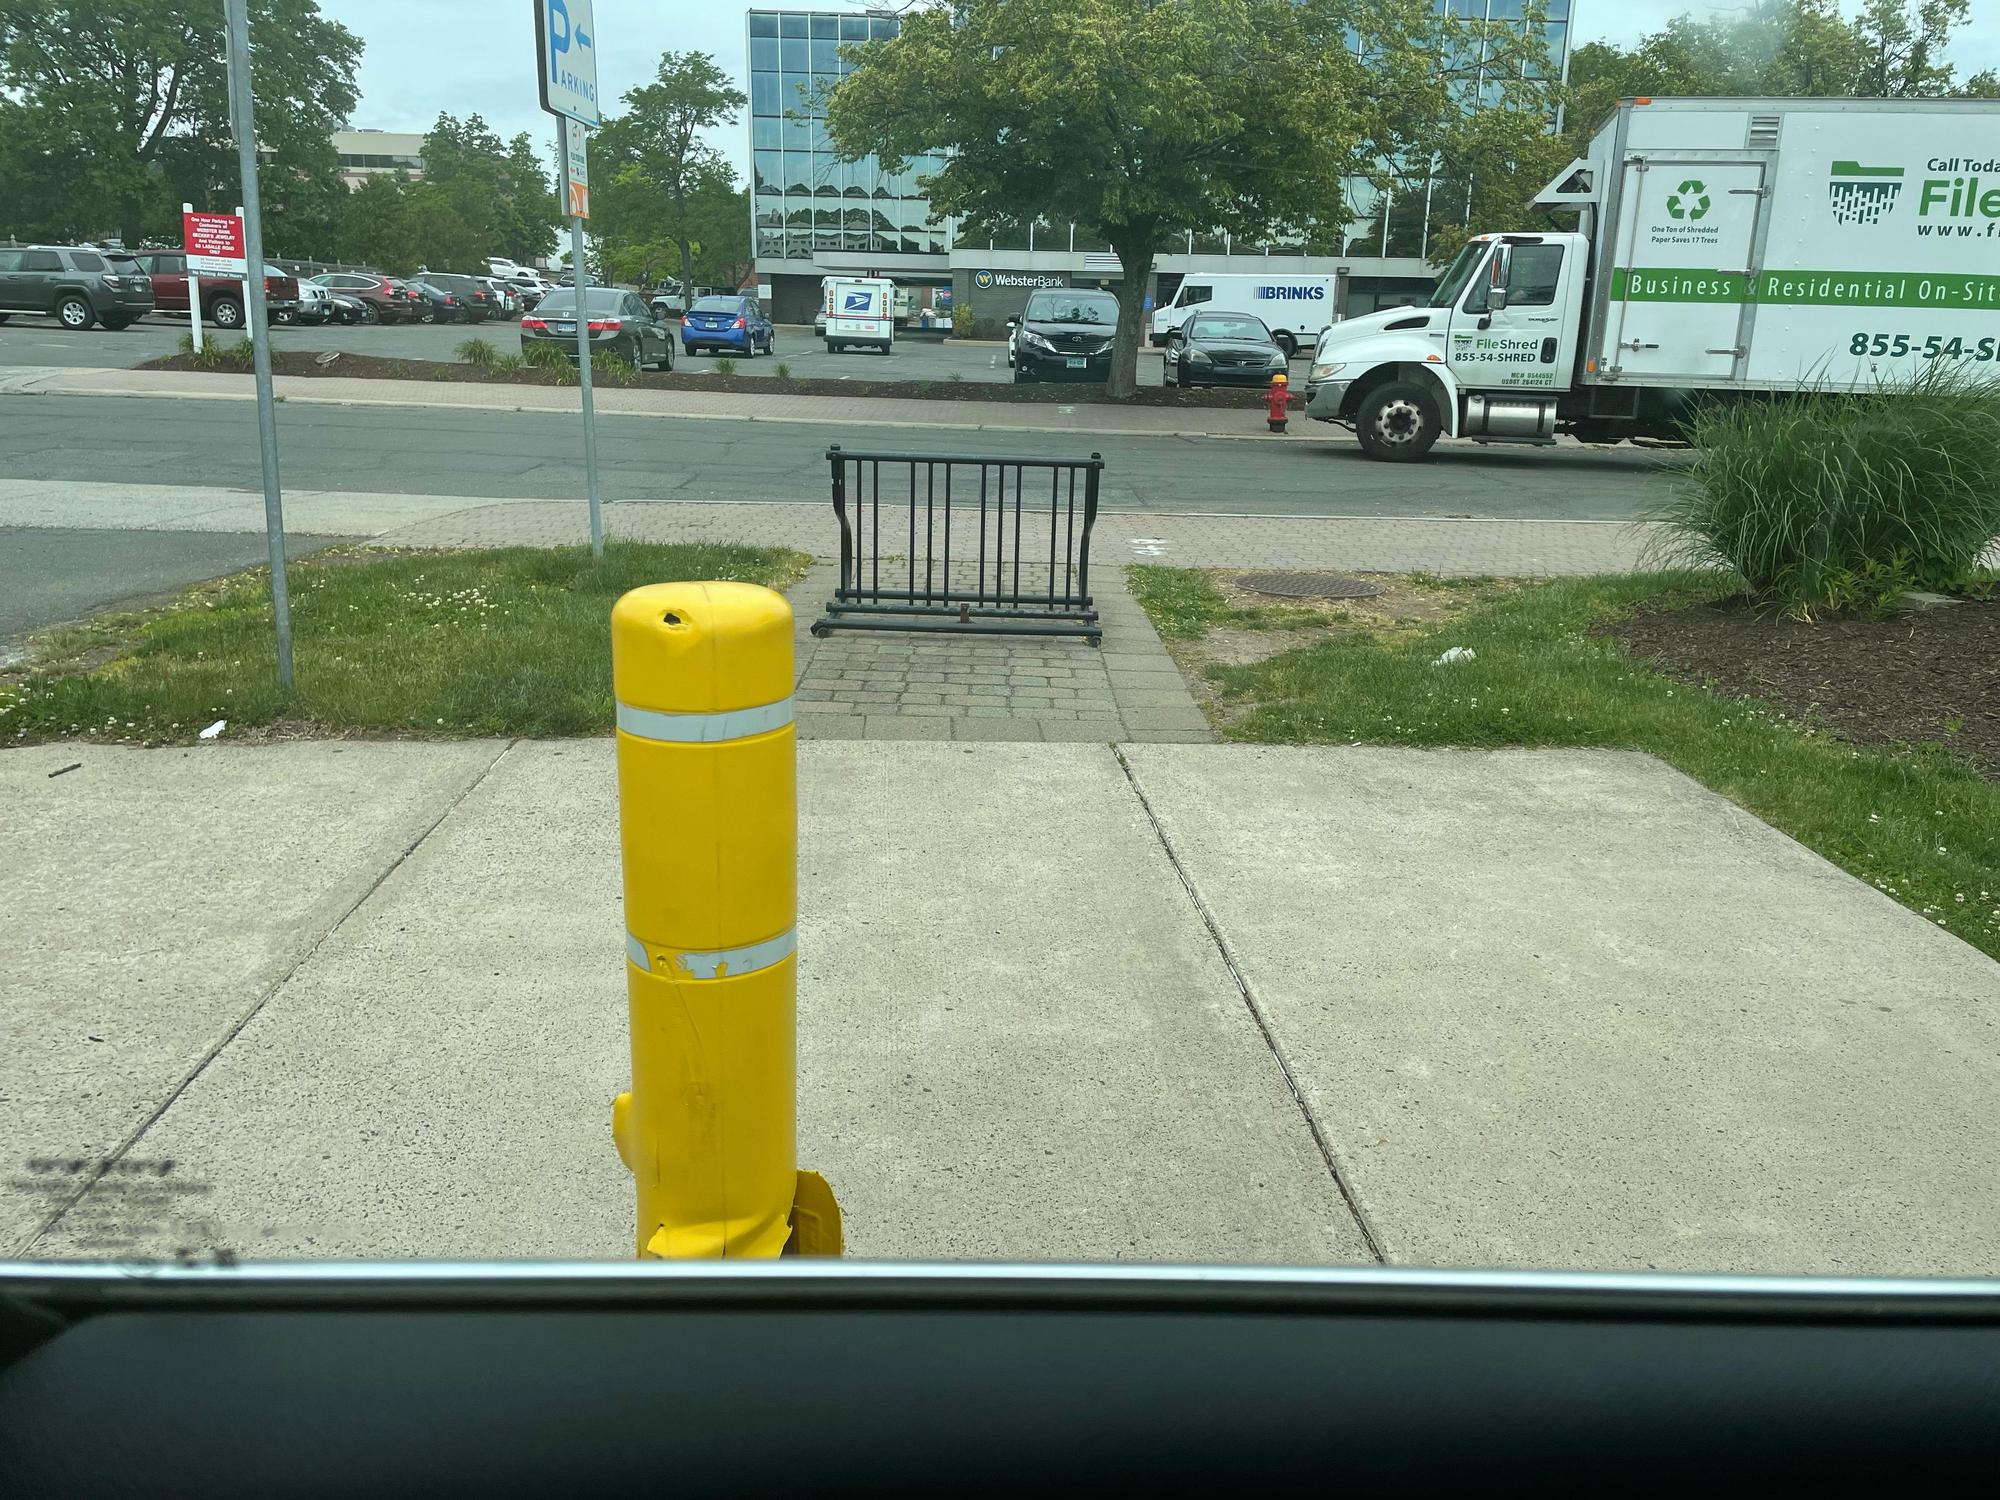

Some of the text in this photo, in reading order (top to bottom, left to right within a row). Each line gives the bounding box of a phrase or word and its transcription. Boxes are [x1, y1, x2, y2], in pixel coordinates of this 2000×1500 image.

[1927, 158, 1960, 172] Call
[1651, 236, 1671, 244] Paper
[995, 275, 1064, 287] WebsterBank
[1631, 275, 1731, 295] Business
[1768, 277, 1906, 299] Residential
[1918, 280, 2000, 301] On-Sit
[1266, 286, 1324, 300] BRINKS
[1850, 332, 2000, 362] 855-54-S
[1455, 353, 1536, 362] 855-54-SHRED
